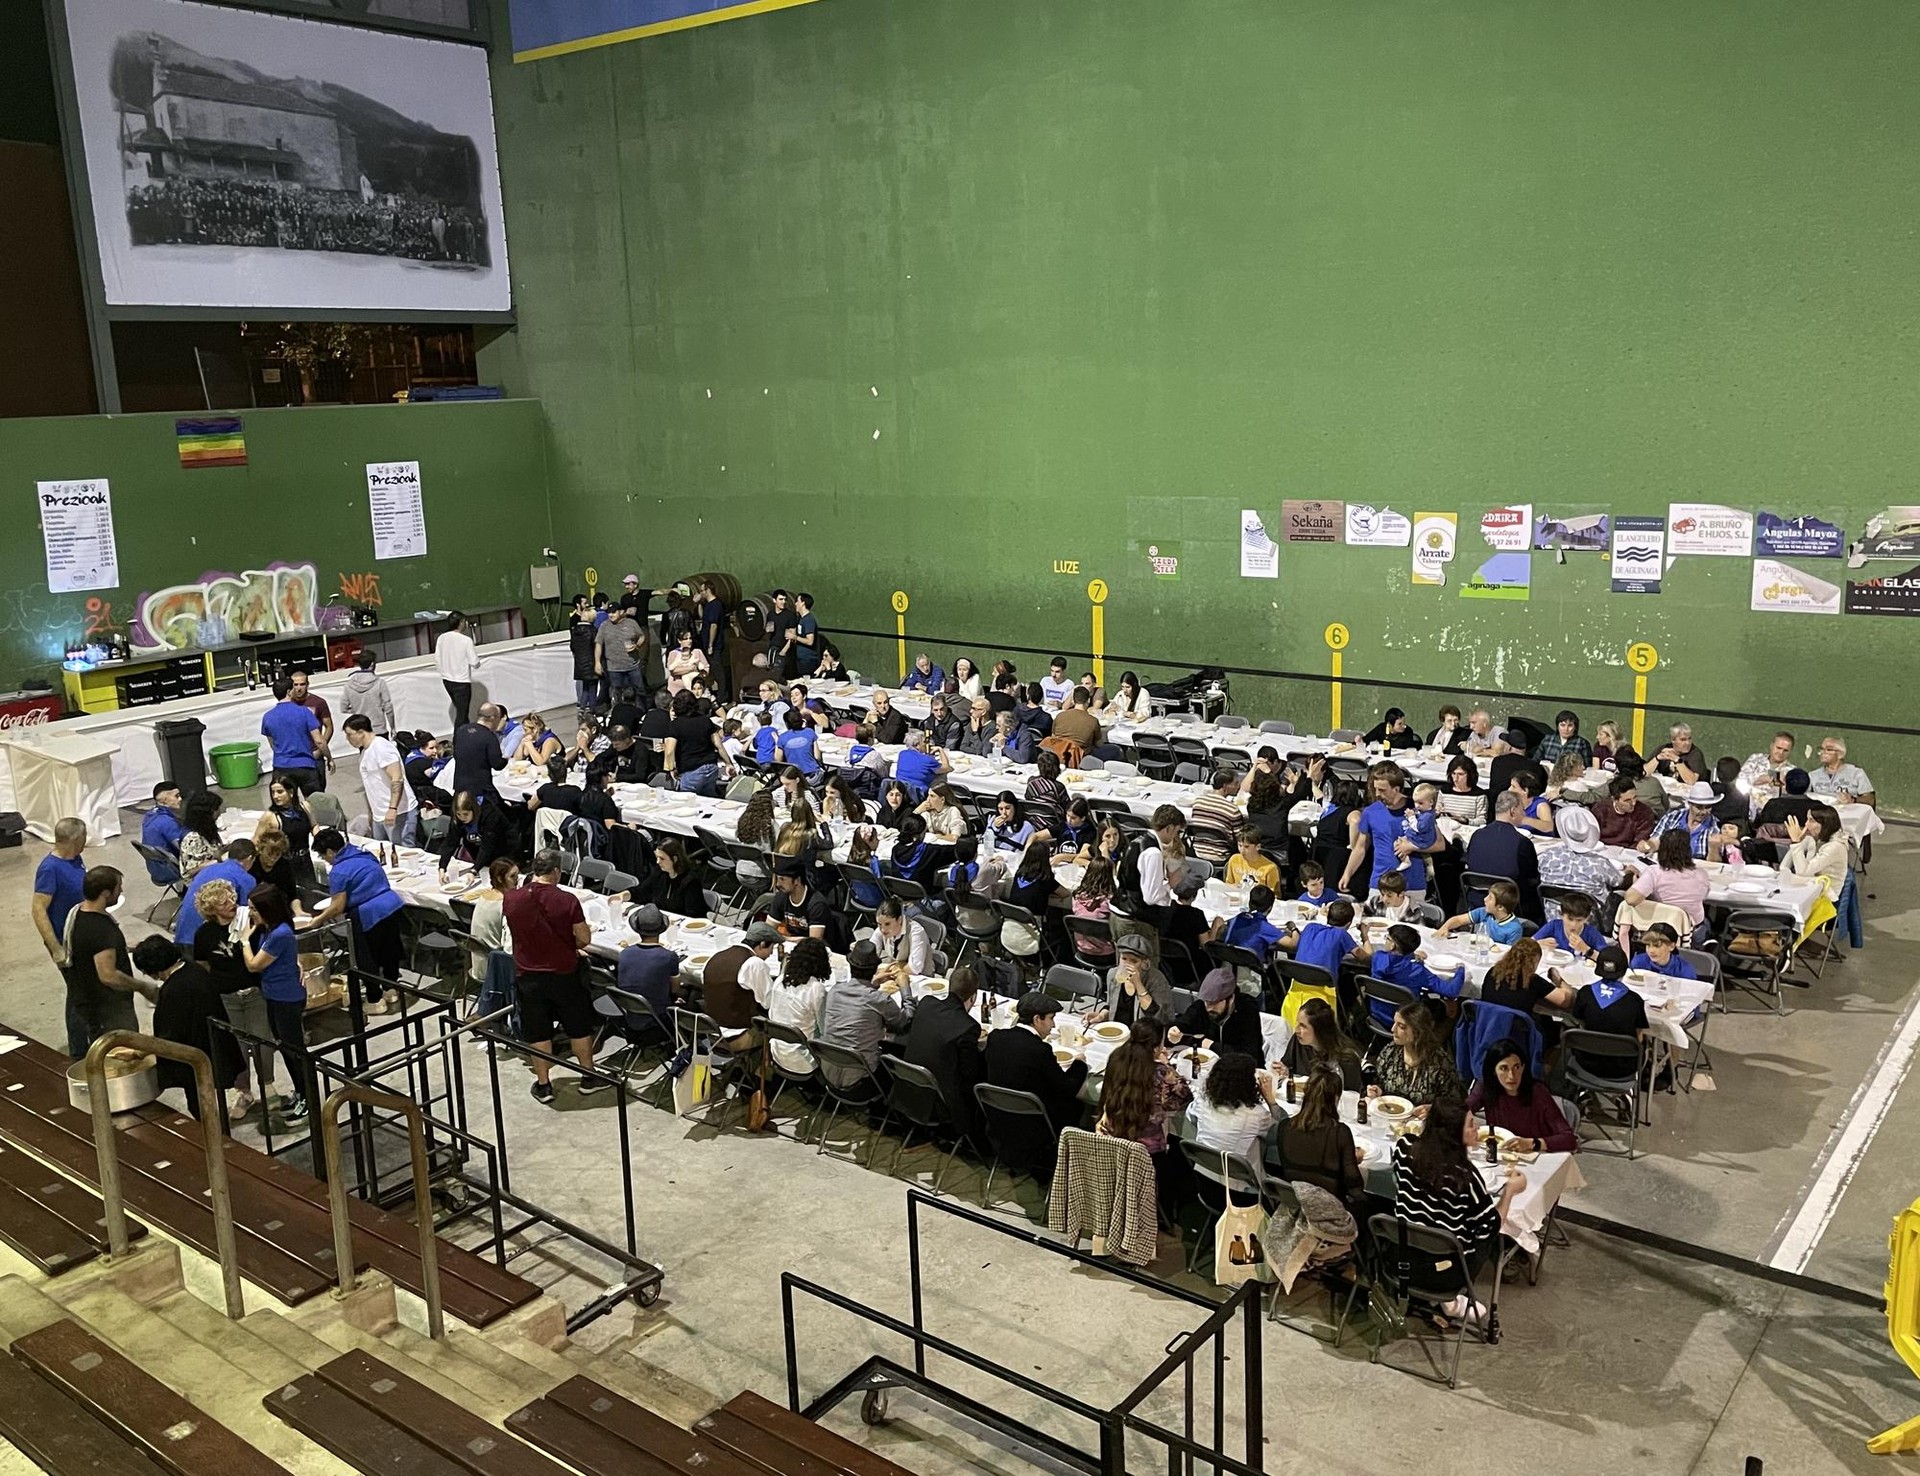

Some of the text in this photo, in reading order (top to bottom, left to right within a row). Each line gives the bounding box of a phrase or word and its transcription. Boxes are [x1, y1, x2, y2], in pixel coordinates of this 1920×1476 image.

[369, 472, 418, 486] Prezioak
[41, 491, 107, 507] Prezioak
[1291, 514, 1333, 528] Sekaña
[1709, 519, 1742, 529] BRUÑO
[1762, 527, 1838, 540] Angulas Mayoz
[1418, 547, 1450, 558] Arrate
[1053, 560, 1080, 574] LUZE
[587, 570, 595, 582] 10
[1093, 583, 1102, 599] 7
[896, 594, 904, 609] 8
[1332, 627, 1342, 645] 6
[1636, 647, 1649, 667] 5
